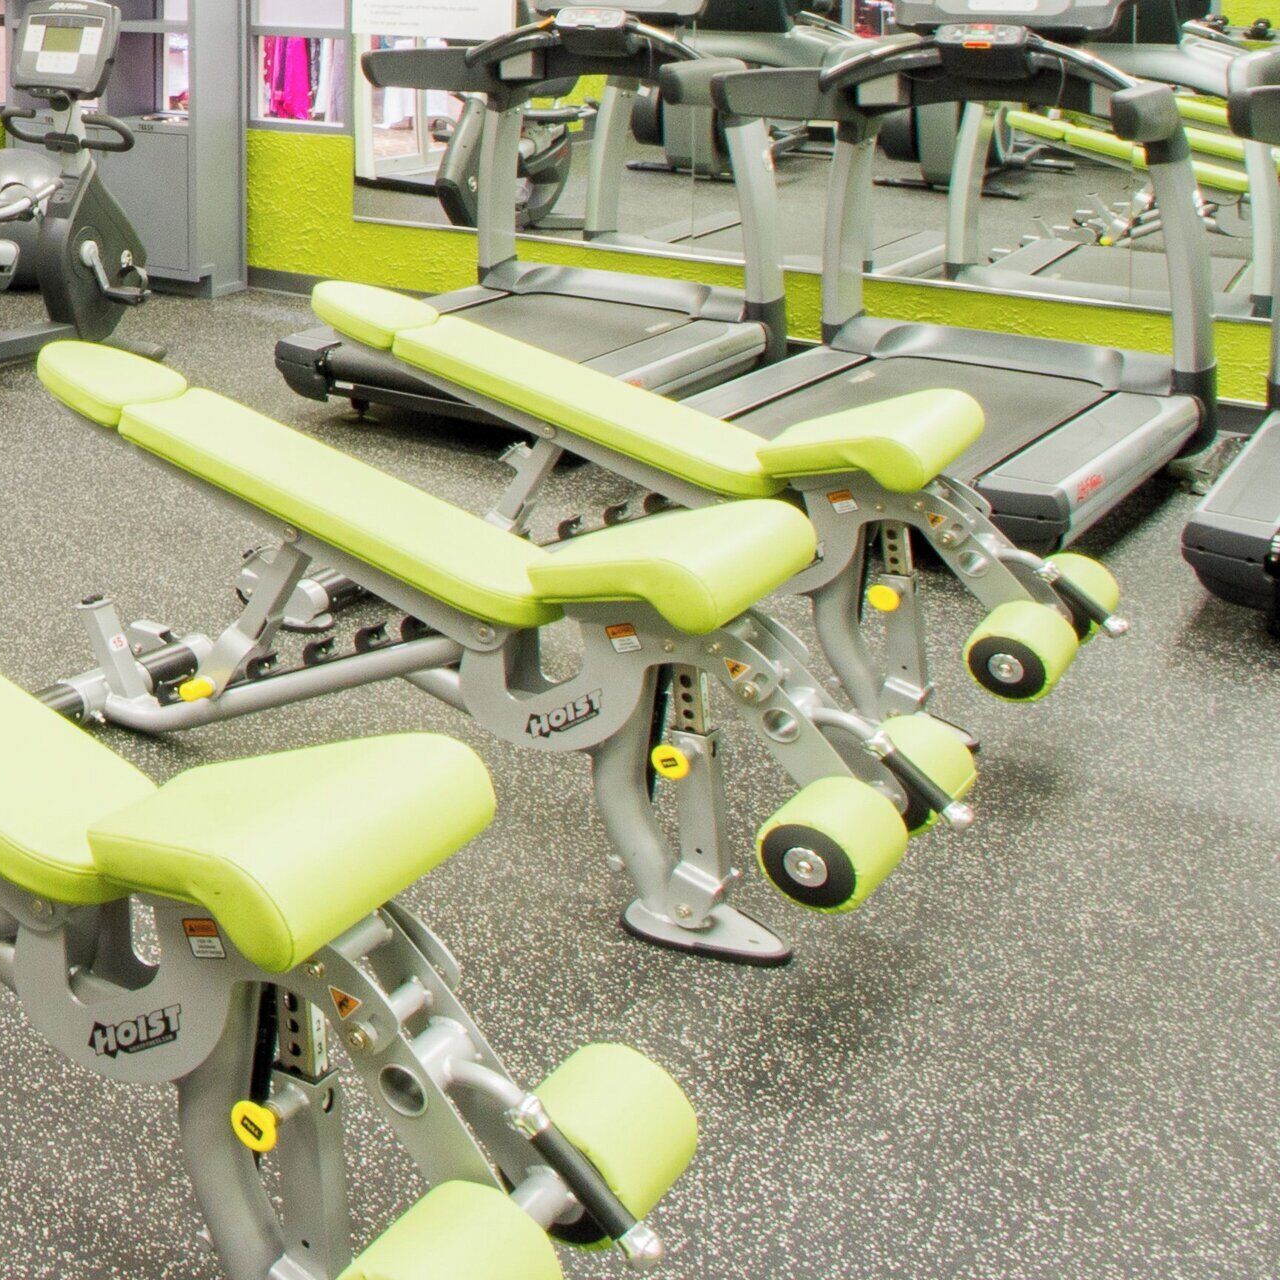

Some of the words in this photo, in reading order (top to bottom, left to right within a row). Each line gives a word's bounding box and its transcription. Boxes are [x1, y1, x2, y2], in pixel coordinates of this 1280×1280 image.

[528, 688, 603, 739] HOIST
[92, 1003, 182, 1056] HOIST
[242, 1117, 261, 1138] PULL
